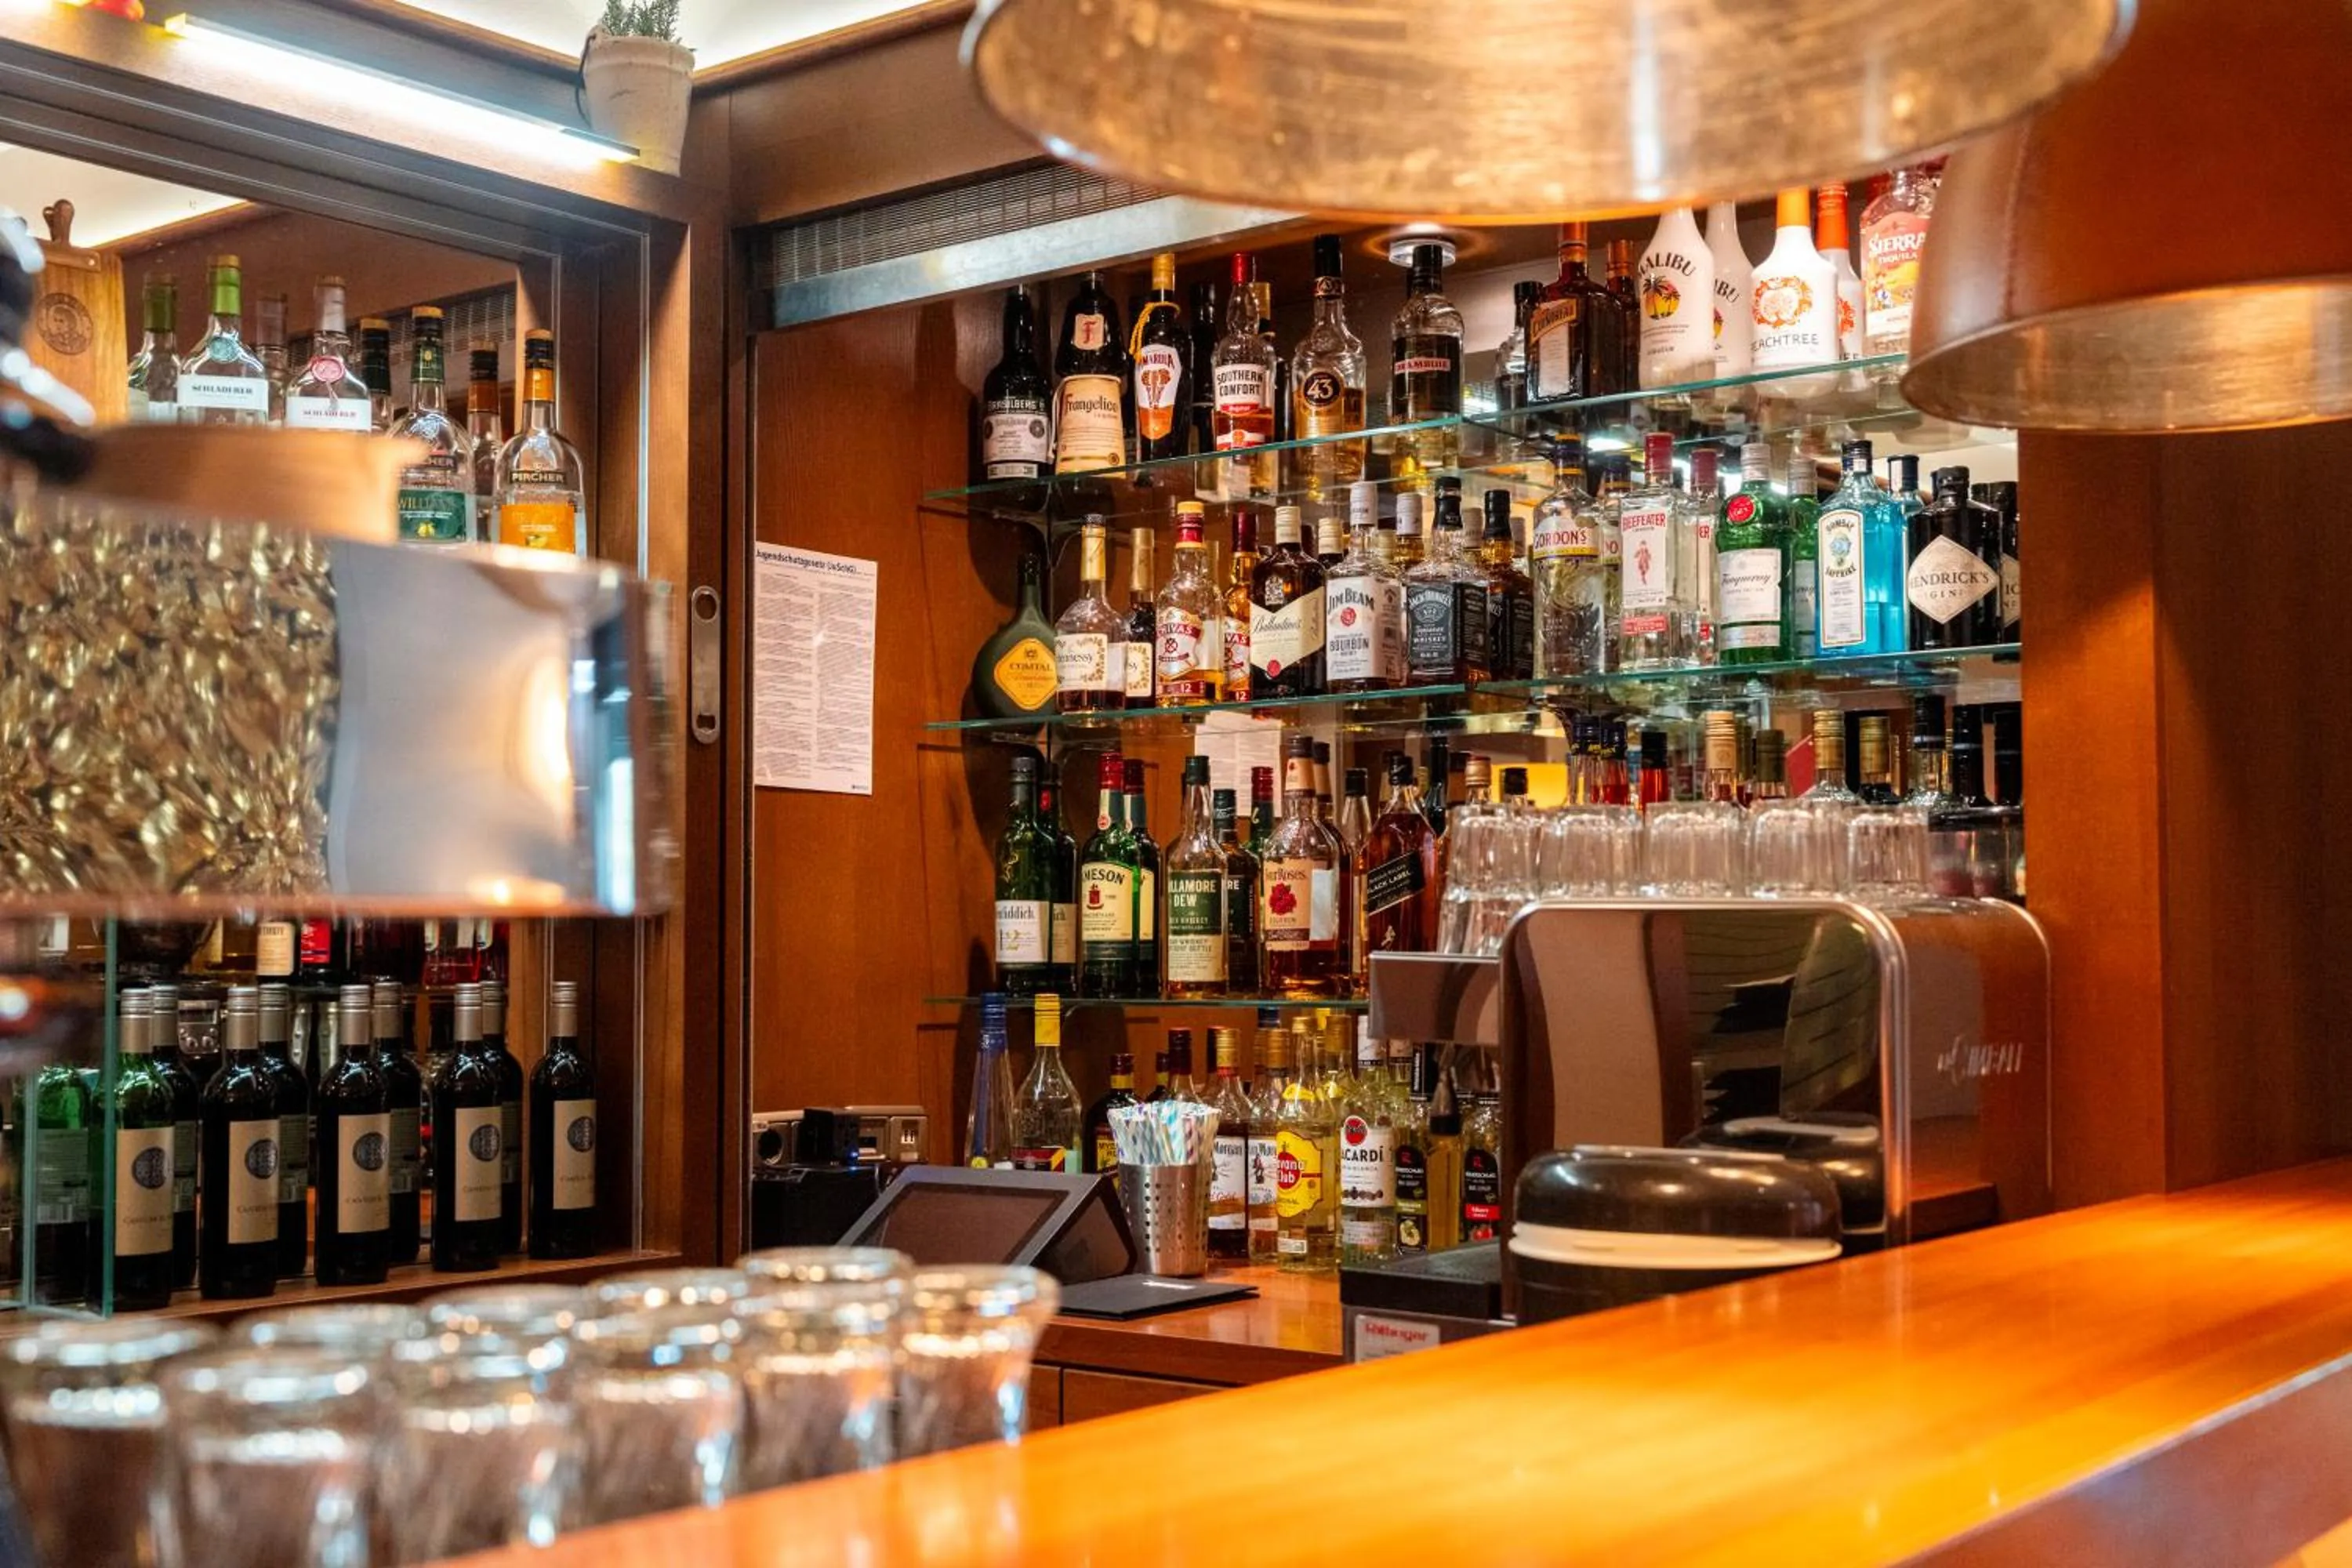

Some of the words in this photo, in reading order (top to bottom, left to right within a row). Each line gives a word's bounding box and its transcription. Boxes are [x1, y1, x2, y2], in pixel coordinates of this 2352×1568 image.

[1715, 278, 1740, 303] IBU
[1751, 334, 1819, 351] EACHTREE
[1142, 354, 1174, 368] MARULA
[1217, 370, 1263, 385] SOUTHERN
[1220, 383, 1261, 396] COMFORT
[1307, 379, 1333, 399] 43
[1065, 394, 1118, 415] Frangelico
[511, 472, 564, 483] PIRCHER
[1622, 513, 1666, 532] BEEFEATER
[1826, 519, 1855, 532] BOMBAY
[1534, 531, 1587, 549] GORDON'S
[1721, 573, 1771, 586] Tanqueray
[1327, 593, 1344, 615] JIM
[1345, 587, 1374, 611] BEAM
[1225, 633, 1247, 645] VAS
[1330, 637, 1370, 652] BOURBON
[1180, 683, 1192, 693] 12
[1235, 691, 1247, 700] 12
[1083, 868, 1125, 885] MESON
[1169, 879, 1216, 892] LLAMORE
[1174, 894, 1197, 907] DEW
[997, 906, 1035, 919] fiddich
[1341, 1145, 1384, 1162] CARDÍ
[1279, 1160, 1305, 1171] vana
